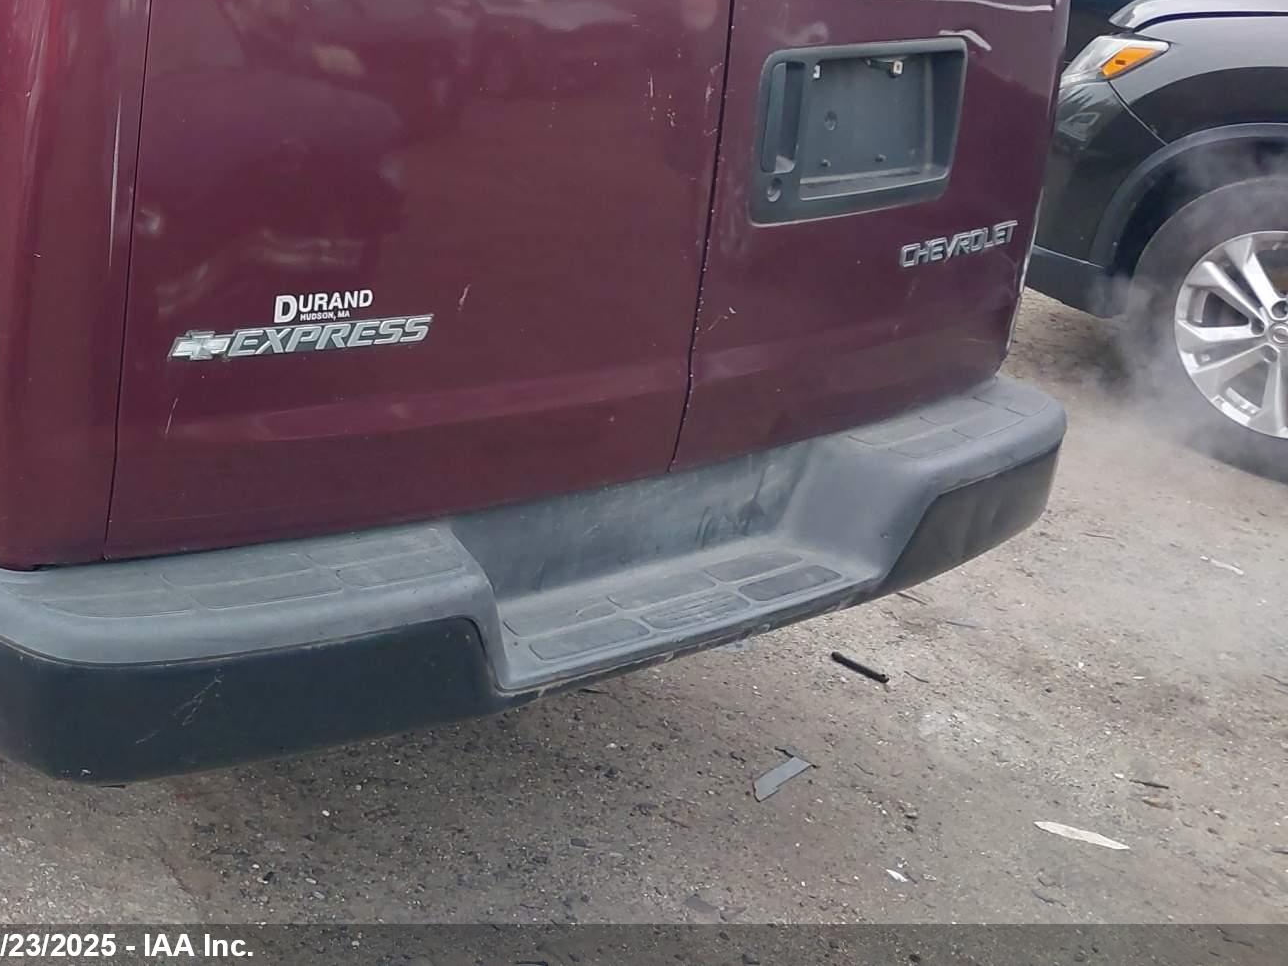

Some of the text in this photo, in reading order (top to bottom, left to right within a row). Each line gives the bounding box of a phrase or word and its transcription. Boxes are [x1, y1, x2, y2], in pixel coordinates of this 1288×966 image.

[900, 220, 1018, 267] CHEVROLET
[273, 289, 373, 324] DURAND
[337, 310, 351, 318] MA
[228, 314, 434, 358] EXPRESS
